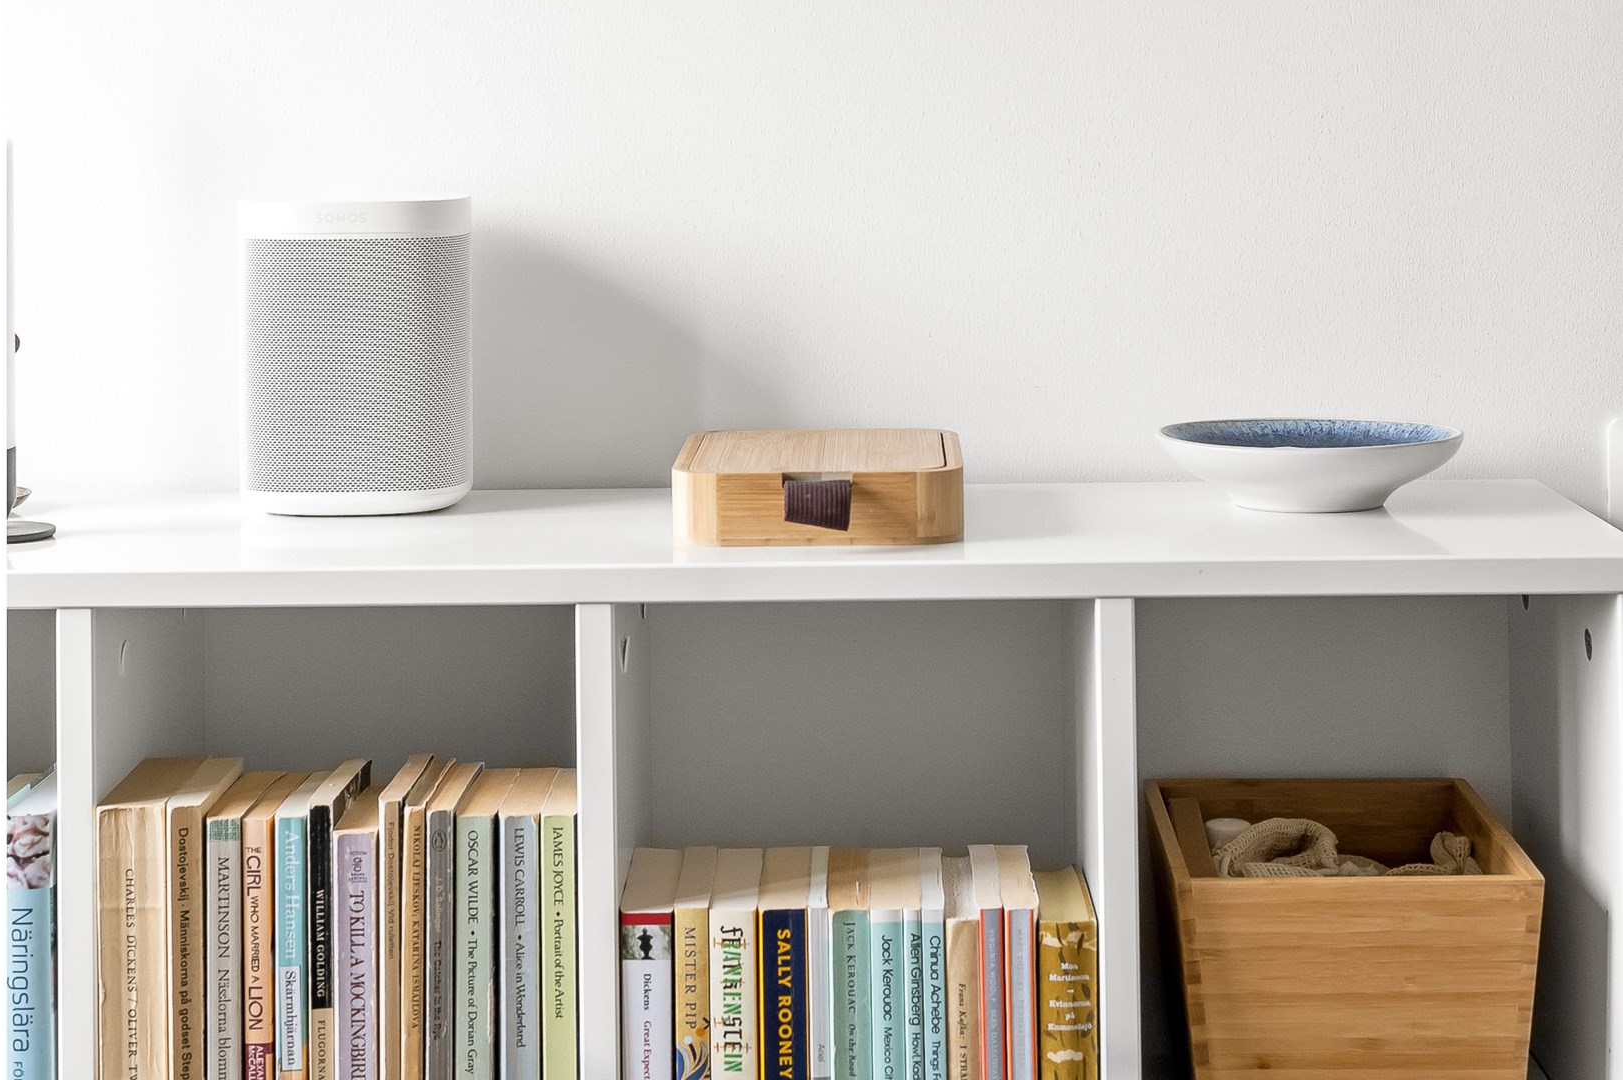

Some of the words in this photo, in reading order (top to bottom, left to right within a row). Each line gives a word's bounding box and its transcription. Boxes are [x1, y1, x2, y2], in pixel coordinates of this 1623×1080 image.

[315, 212, 368, 224] SONOS
[386, 822, 395, 851] Fjodor
[412, 825, 421, 868] NIKOLAJ
[468, 830, 479, 877] OSCAR
[514, 827, 525, 867] LEWIS
[552, 826, 564, 867] JAMES
[177, 827, 189, 902] Dostojevskij
[247, 855, 262, 896] GIRL
[284, 830, 300, 890] Anders
[125, 869, 135, 928] CHARLES
[386, 853, 395, 907] Dostojevskij
[514, 869, 525, 927] CARROLL
[552, 869, 564, 906] JOYCE
[217, 856, 230, 958] MARTINSON
[250, 896, 260, 923] WHO
[316, 889, 325, 941] WILLIAM
[349, 890, 365, 914] TO
[387, 910, 395, 924] Vid
[468, 881, 479, 925] WILDE
[285, 893, 300, 959] Hansen
[350, 917, 366, 954] KILL
[387, 926, 395, 960] ruletten
[554, 919, 564, 956] Portrait
[842, 922, 856, 950] JACK
[126, 935, 136, 993] DICKENS
[179, 910, 191, 987] Människorna
[250, 925, 260, 973] MARRIED
[350, 955, 365, 969] A
[411, 920, 421, 971] KATARINA
[434, 939, 442, 957] The
[468, 938, 479, 958] The
[515, 942, 526, 970] Alice
[554, 957, 565, 970] of
[685, 927, 697, 994] MISTER
[777, 929, 792, 988] SALLY
[881, 934, 894, 966] Jack
[911, 933, 921, 965] Allen
[930, 935, 942, 980] Chinua
[989, 928, 997, 968] VIRGINIA
[7, 908, 35, 1052] Näringslära
[316, 944, 325, 998] GOLDING
[433, 959, 442, 994] Catcher
[468, 960, 478, 996] Picture
[515, 972, 526, 983] in
[554, 971, 564, 988] the
[846, 954, 857, 1014] KEROUAC
[1049, 973, 1090, 981] Martinson
[1060, 962, 1078, 970] Moa
[178, 990, 192, 1005] på
[217, 969, 232, 1032] Nässlorna
[411, 975, 420, 1029] ISMAJLOVA
[468, 997, 479, 1009] of
[555, 988, 565, 1019] Artist
[643, 973, 652, 1011] Dickens
[883, 968, 894, 1021] Kerouac
[909, 967, 922, 1026] Ginsberg
[958, 983, 967, 1007] Franz
[989, 971, 997, 1002] WOOLF
[1049, 1000, 1091, 1008] Kvinnorna
[248, 986, 264, 1031] LION
[284, 970, 298, 1066] Skärmhjärnan
[433, 1006, 441, 1020] the
[515, 983, 527, 1049] Wonderland
[685, 1003, 697, 1030] PIP
[930, 983, 942, 1034] Achebe
[1065, 1012, 1075, 1021] på
[127, 1009, 137, 1058] OLIVER
[178, 1009, 192, 1046] godset
[432, 1022, 441, 1040] Rye
[468, 1011, 478, 1046] Dorian
[643, 1021, 652, 1047] Great
[777, 995, 793, 1079] ROONEY
[847, 1023, 857, 1036] On
[848, 1038, 857, 1053] the
[884, 1026, 893, 1064] Mexico
[465, 1049, 478, 1074] Gray
[848, 1055, 857, 1077] Road
[930, 1040, 941, 1071] Things
